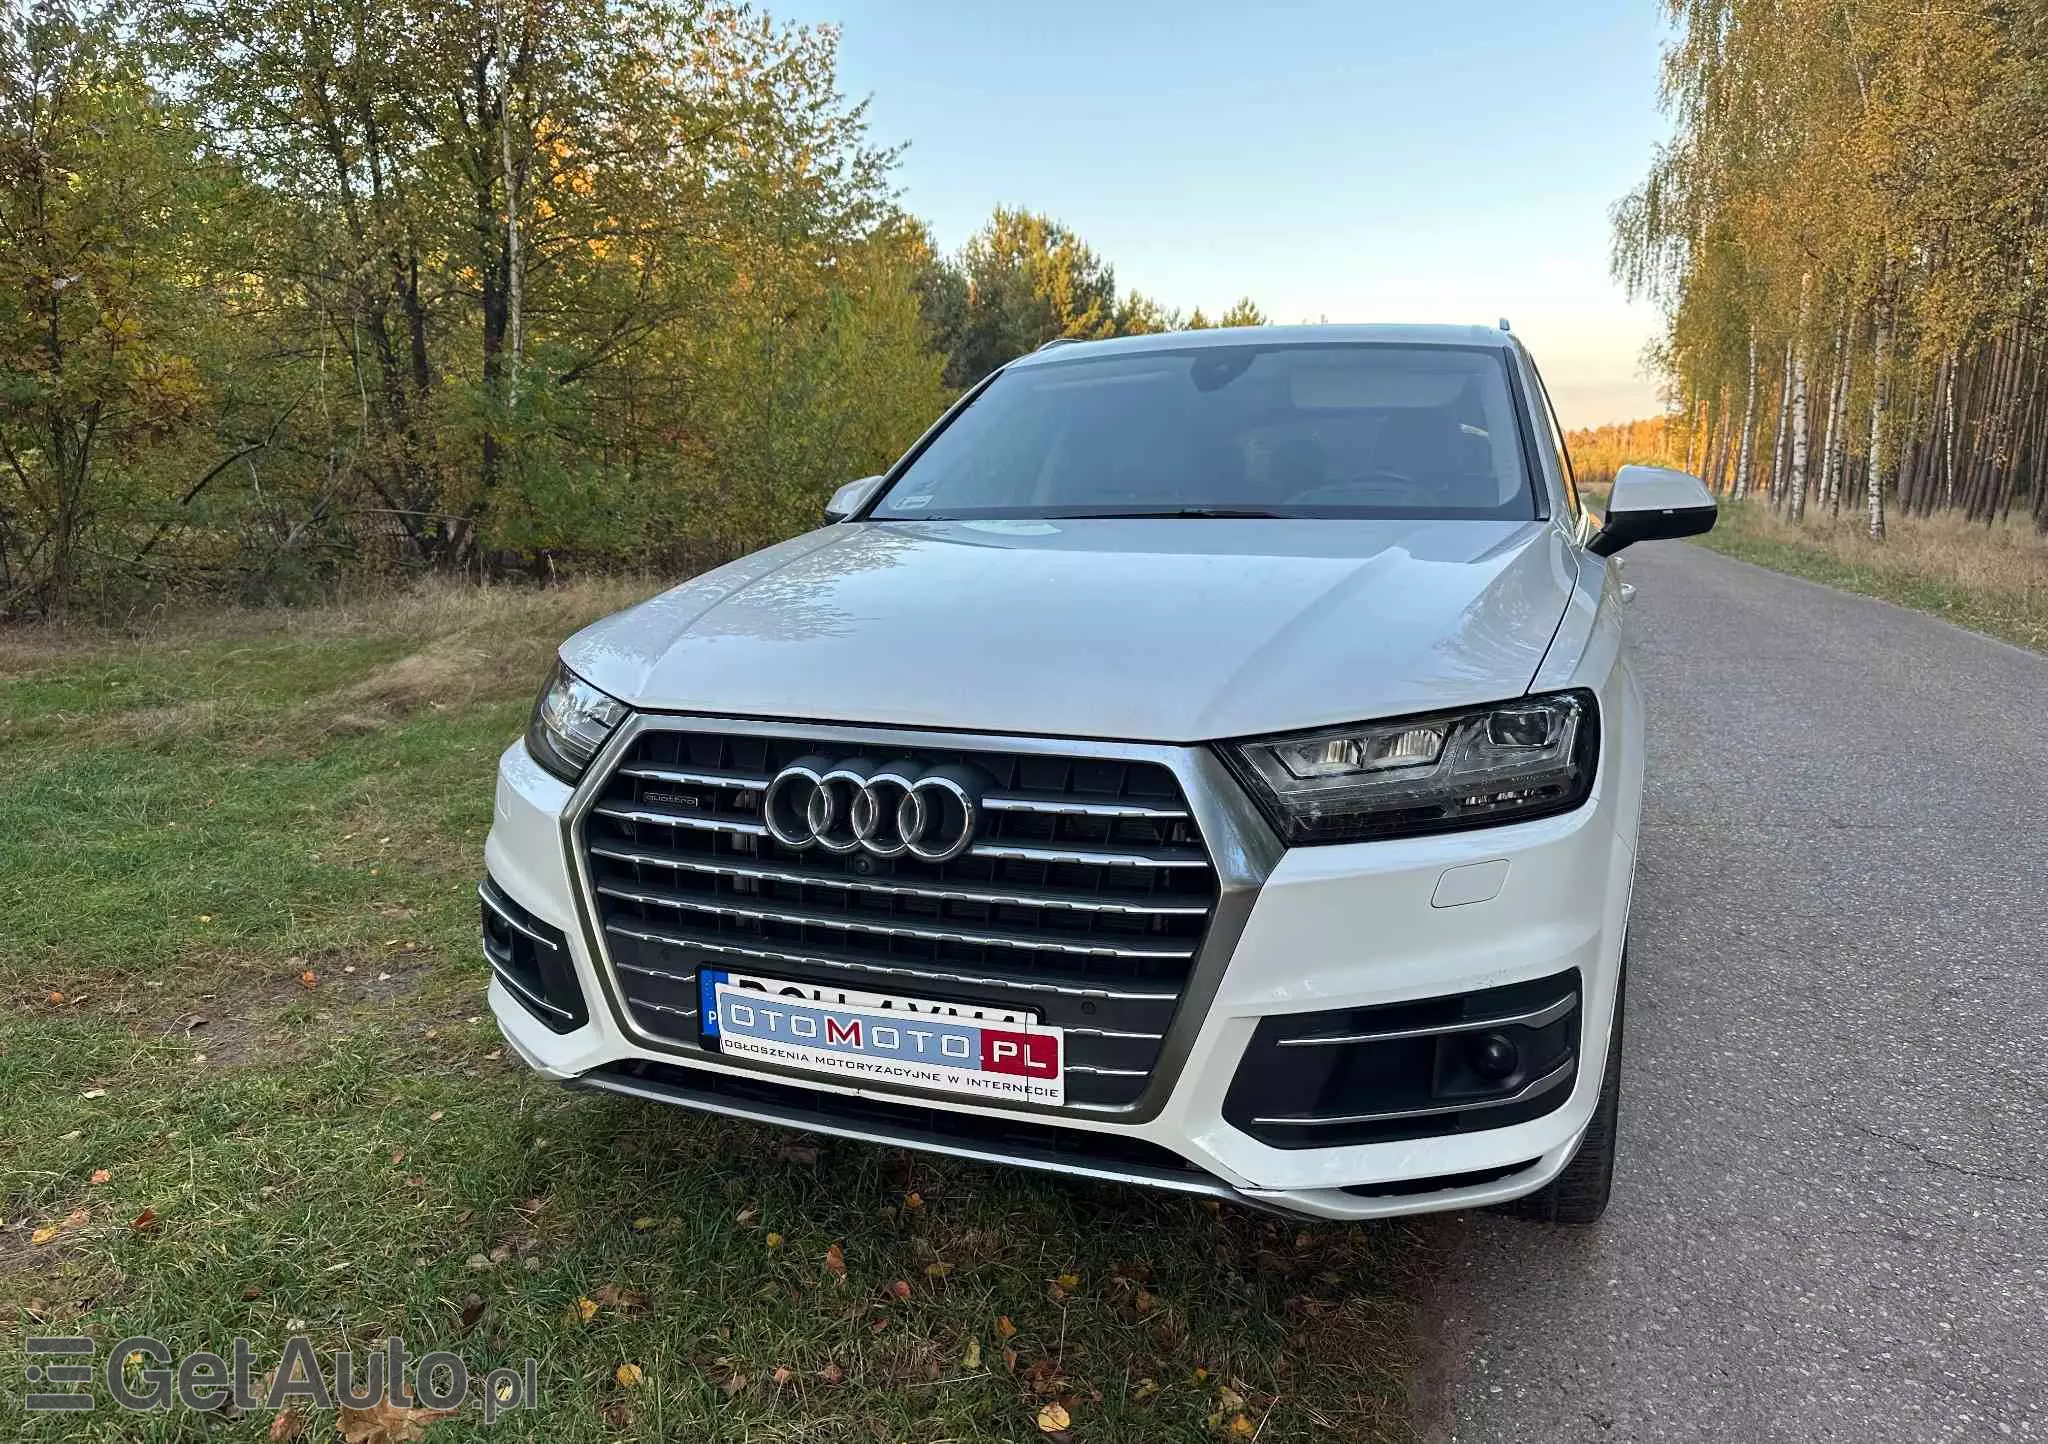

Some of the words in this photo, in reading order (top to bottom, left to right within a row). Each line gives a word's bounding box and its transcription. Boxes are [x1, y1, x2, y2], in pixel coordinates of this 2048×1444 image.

[646, 794, 696, 805] quattro
[724, 1039, 809, 1062] OGŁOSZENIA
[815, 1056, 941, 1082] MOTORYZACYJNE
[947, 1074, 960, 1085] W
[966, 1077, 1060, 1098] INTERNECIE
